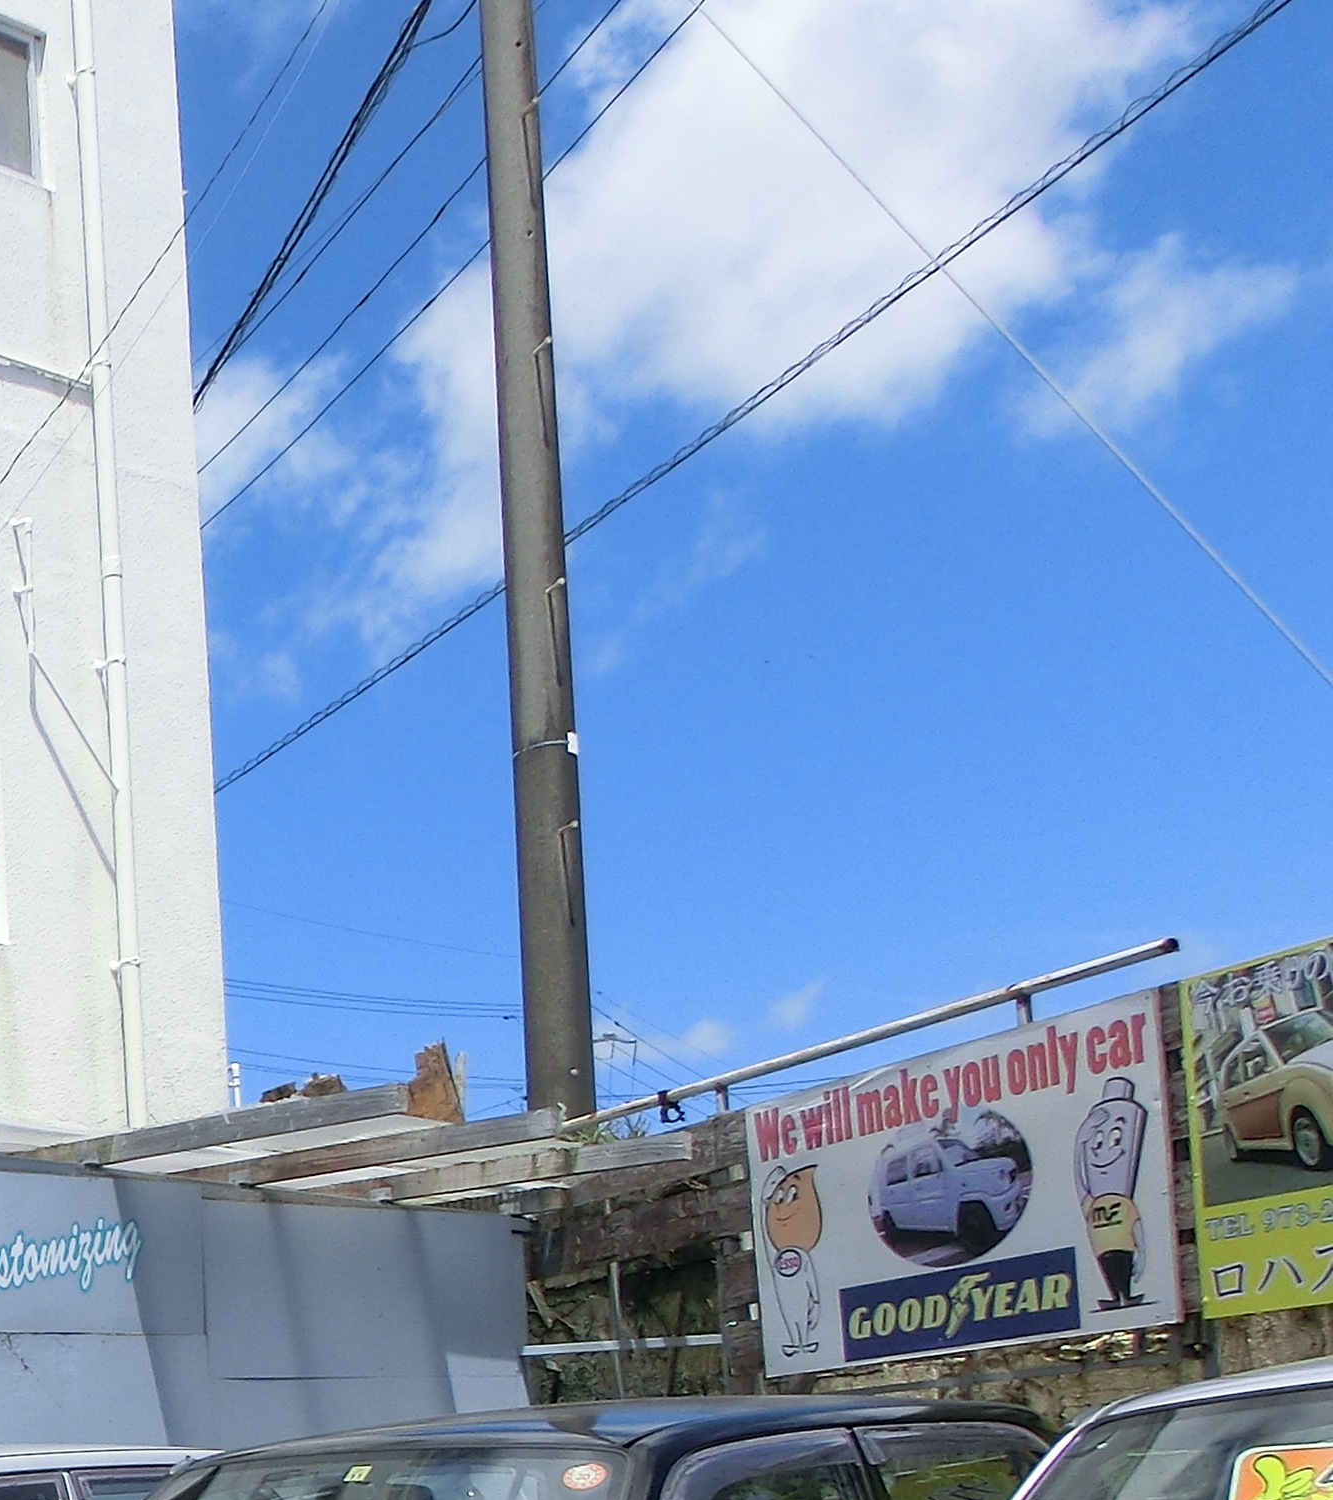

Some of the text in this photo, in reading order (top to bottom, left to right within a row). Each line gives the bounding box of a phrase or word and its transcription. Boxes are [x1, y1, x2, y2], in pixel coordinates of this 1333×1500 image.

[754, 1013, 1146, 1162] We will make you only car
[1205, 1213, 1254, 1240] TEL
